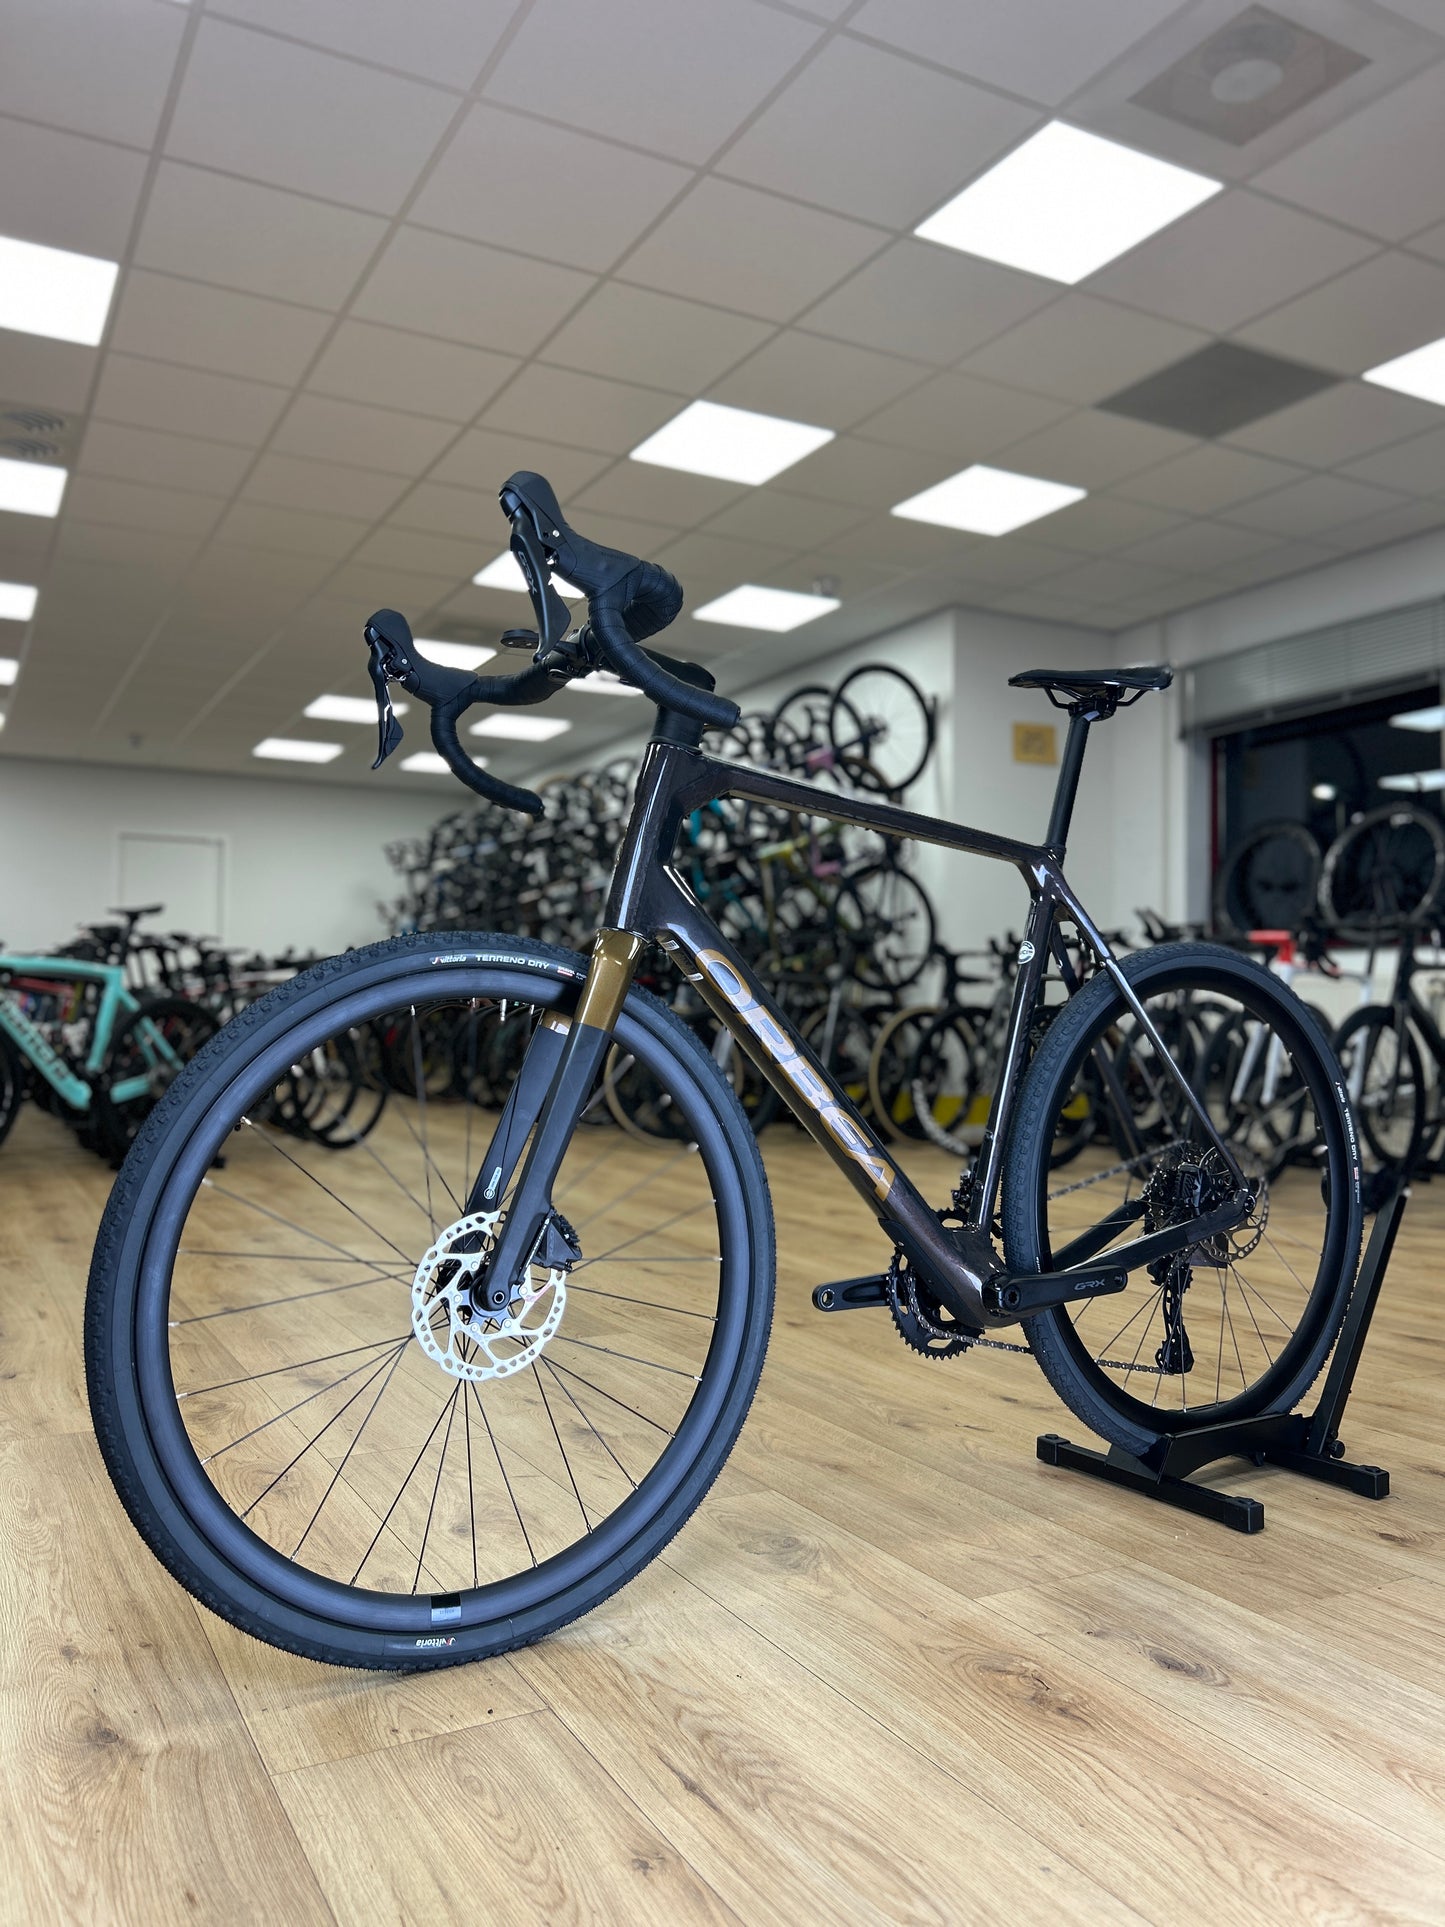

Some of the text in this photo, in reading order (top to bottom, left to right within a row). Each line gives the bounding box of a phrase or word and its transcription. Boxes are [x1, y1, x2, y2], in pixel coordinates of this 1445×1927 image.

[518, 551, 537, 595] GRX
[440, 955, 467, 964] vittoria
[475, 954, 550, 970] TERRENO DRY
[695, 949, 896, 1201] ORBEA
[1074, 1279, 1105, 1291] GRX
[416, 1637, 447, 1648] vittoria
